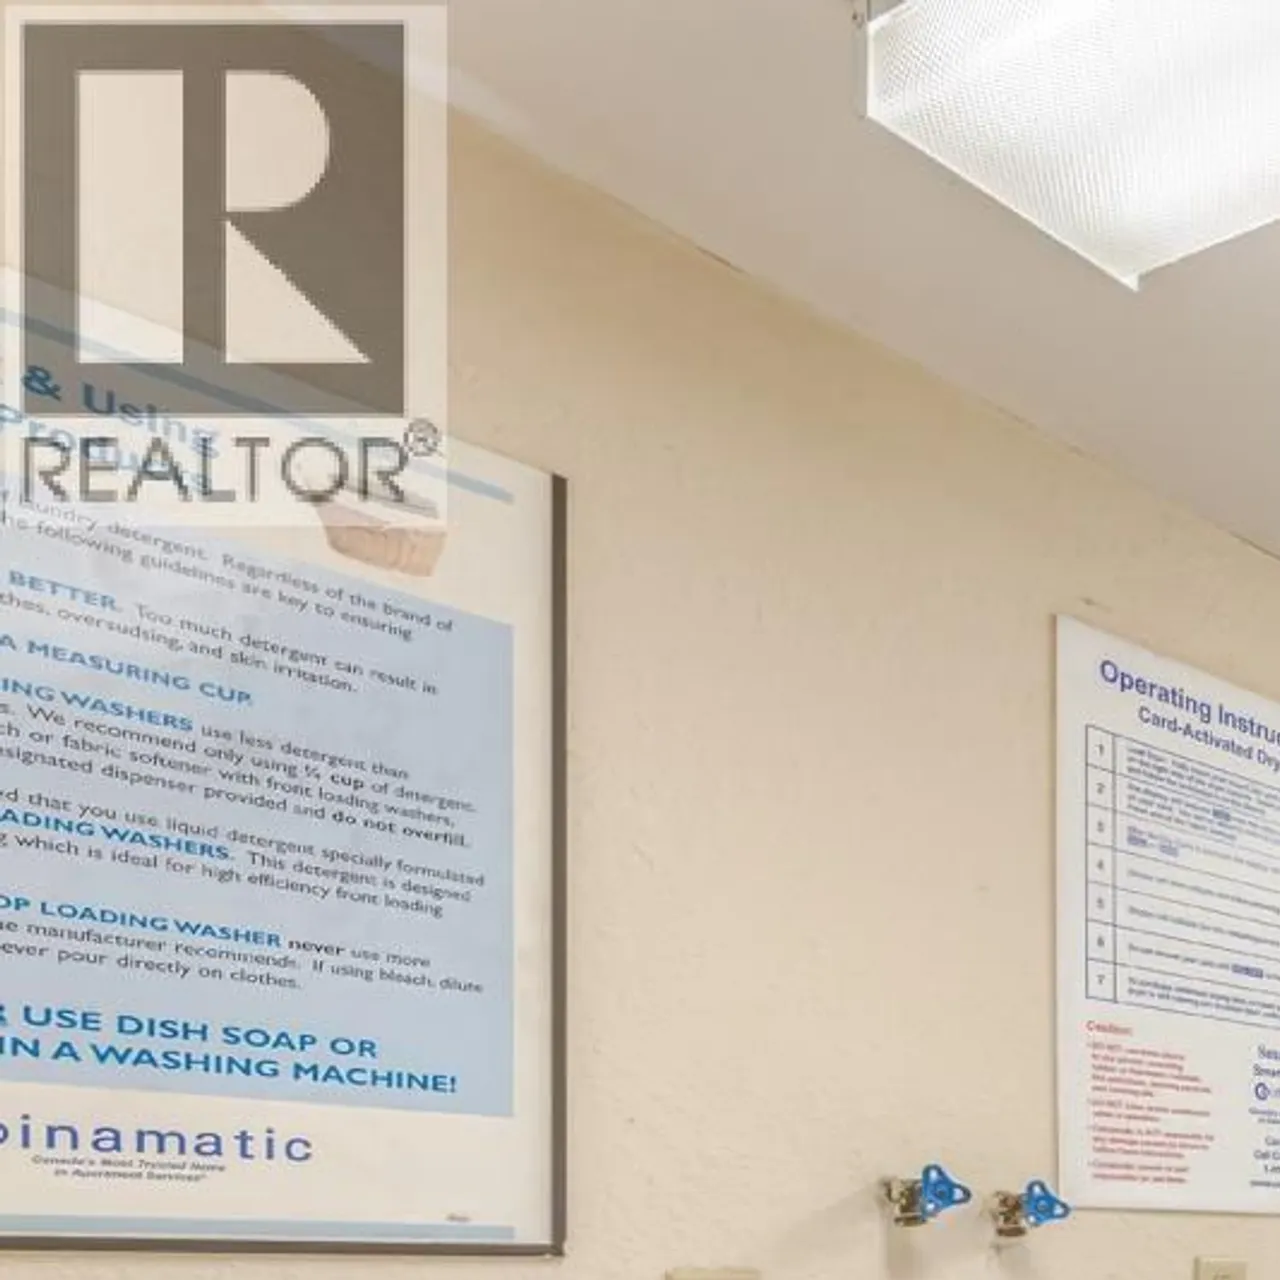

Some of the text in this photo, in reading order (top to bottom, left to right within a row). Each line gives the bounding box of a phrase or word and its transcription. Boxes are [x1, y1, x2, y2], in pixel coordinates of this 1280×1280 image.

[37, 520, 134, 564] following
[139, 553, 236, 590] guidelines
[242, 582, 271, 599] are
[278, 589, 309, 613] key
[315, 602, 335, 618] to
[222, 551, 318, 594] Regardless
[325, 587, 344, 601] of
[349, 593, 376, 610] the
[383, 600, 431, 626] brand
[436, 618, 453, 633] of
[0, 633, 254, 708] A MEASURING CUP.
[136, 602, 172, 626] Too
[179, 617, 232, 643] much
[239, 633, 327, 667] detergent
[334, 658, 364, 676] can
[369, 667, 417, 691] result
[422, 679, 438, 695] in
[189, 640, 223, 660] and
[230, 651, 268, 671] skin
[273, 660, 358, 693] irritation.
[1099, 658, 1211, 723] Operating
[27, 702, 66, 727] We
[73, 717, 197, 753] recommend
[203, 746, 244, 768] only
[250, 756, 299, 779] using
[330, 770, 365, 791] cup
[371, 780, 390, 795] of
[60, 689, 194, 733] WASHERS
[201, 724, 232, 742] use
[239, 730, 273, 751] less
[280, 742, 367, 774] detergent
[371, 761, 410, 781] than
[1138, 705, 1252, 760] Card-Activated
[29, 730, 54, 745] or
[62, 733, 122, 759] fabric
[129, 750, 212, 777] softener
[218, 768, 261, 786] with
[266, 776, 313, 799] front
[319, 788, 380, 816] loading
[384, 802, 456, 829] washers,
[100, 763, 197, 797] dispenser
[203, 786, 288, 813] provided
[293, 804, 326, 820] and
[331, 810, 357, 826] do
[363, 818, 397, 835] not
[402, 826, 473, 849] overfill.
[14, 833, 79, 857] which
[88, 846, 103, 861] is
[111, 849, 159, 870] ideal
[166, 857, 195, 875] for
[201, 864, 242, 885] high
[247, 872, 330, 900] efficiency
[335, 886, 378, 907] front
[384, 894, 444, 919] loading
[28, 793, 72, 812] that
[78, 803, 117, 819] you
[124, 812, 159, 828] use
[166, 816, 219, 841] liquid
[226, 829, 315, 857] detergent
[321, 848, 392, 871] specially
[396, 857, 485, 887] formulated
[100, 825, 236, 861] WASHERS.
[247, 850, 286, 871] This
[292, 861, 377, 887] detergent
[383, 876, 396, 890] is
[401, 878, 472, 904] designed
[26, 923, 167, 953] manufacturer
[313, 960, 324, 974] If
[331, 964, 374, 983] using
[439, 977, 484, 995] dilute
[40, 900, 169, 932] LOADING
[173, 918, 282, 949] WASHER
[288, 938, 345, 957] never
[351, 949, 380, 963] use
[386, 953, 431, 969] more
[57, 948, 108, 967] pour
[117, 953, 190, 979] directly
[198, 966, 223, 981] on
[228, 968, 301, 990] clothes.
[23, 1004, 102, 1033] USE
[116, 1014, 209, 1043] DISH
[222, 1024, 319, 1055] SOAP
[329, 1036, 379, 1060] OR
[51, 1040, 81, 1062] A
[89, 1043, 280, 1079] WASHING
[292, 1060, 458, 1095] MACHINE!
